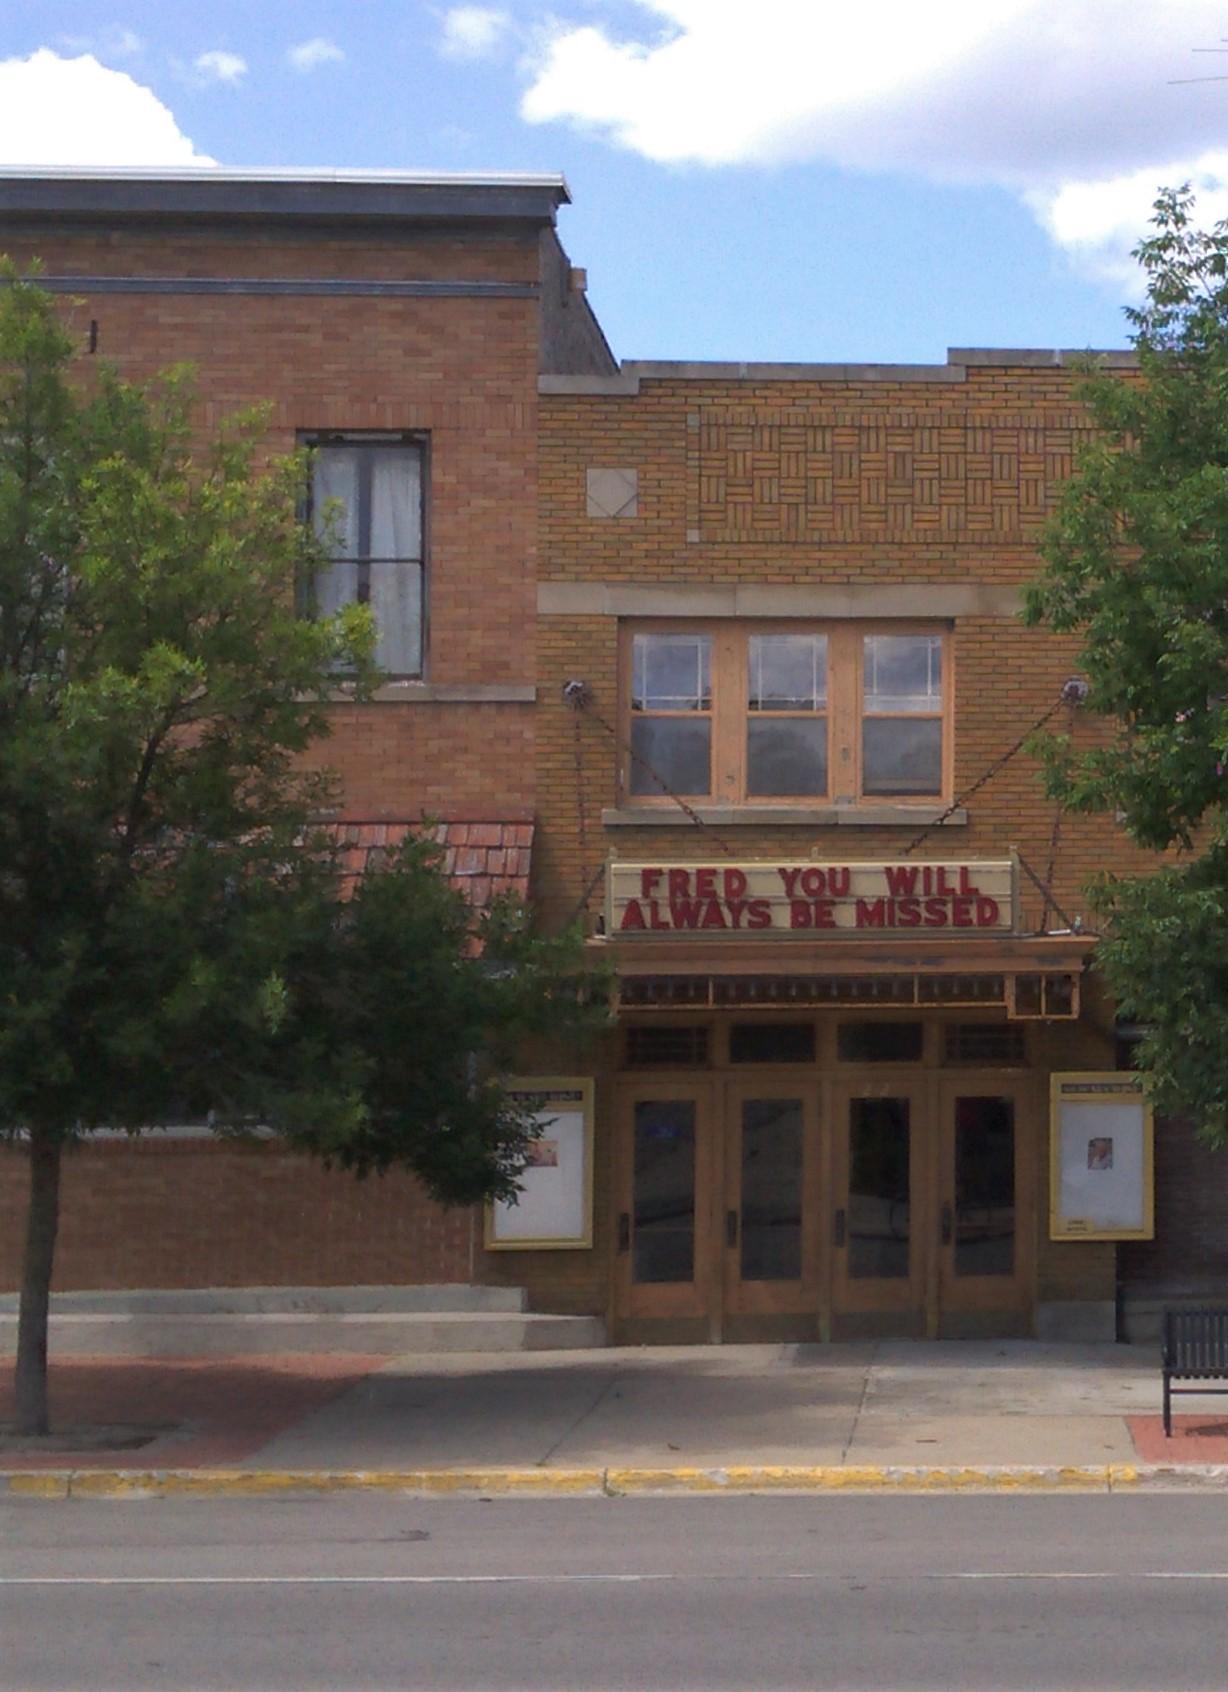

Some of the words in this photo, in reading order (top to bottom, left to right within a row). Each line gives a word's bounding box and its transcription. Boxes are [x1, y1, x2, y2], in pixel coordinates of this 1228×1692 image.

[642, 868, 747, 899] FRED
[777, 867, 851, 898] YOU
[884, 866, 980, 897] WILL
[620, 899, 772, 930] ALWAYS
[790, 900, 836, 929] BE
[856, 898, 999, 928] MISSED
